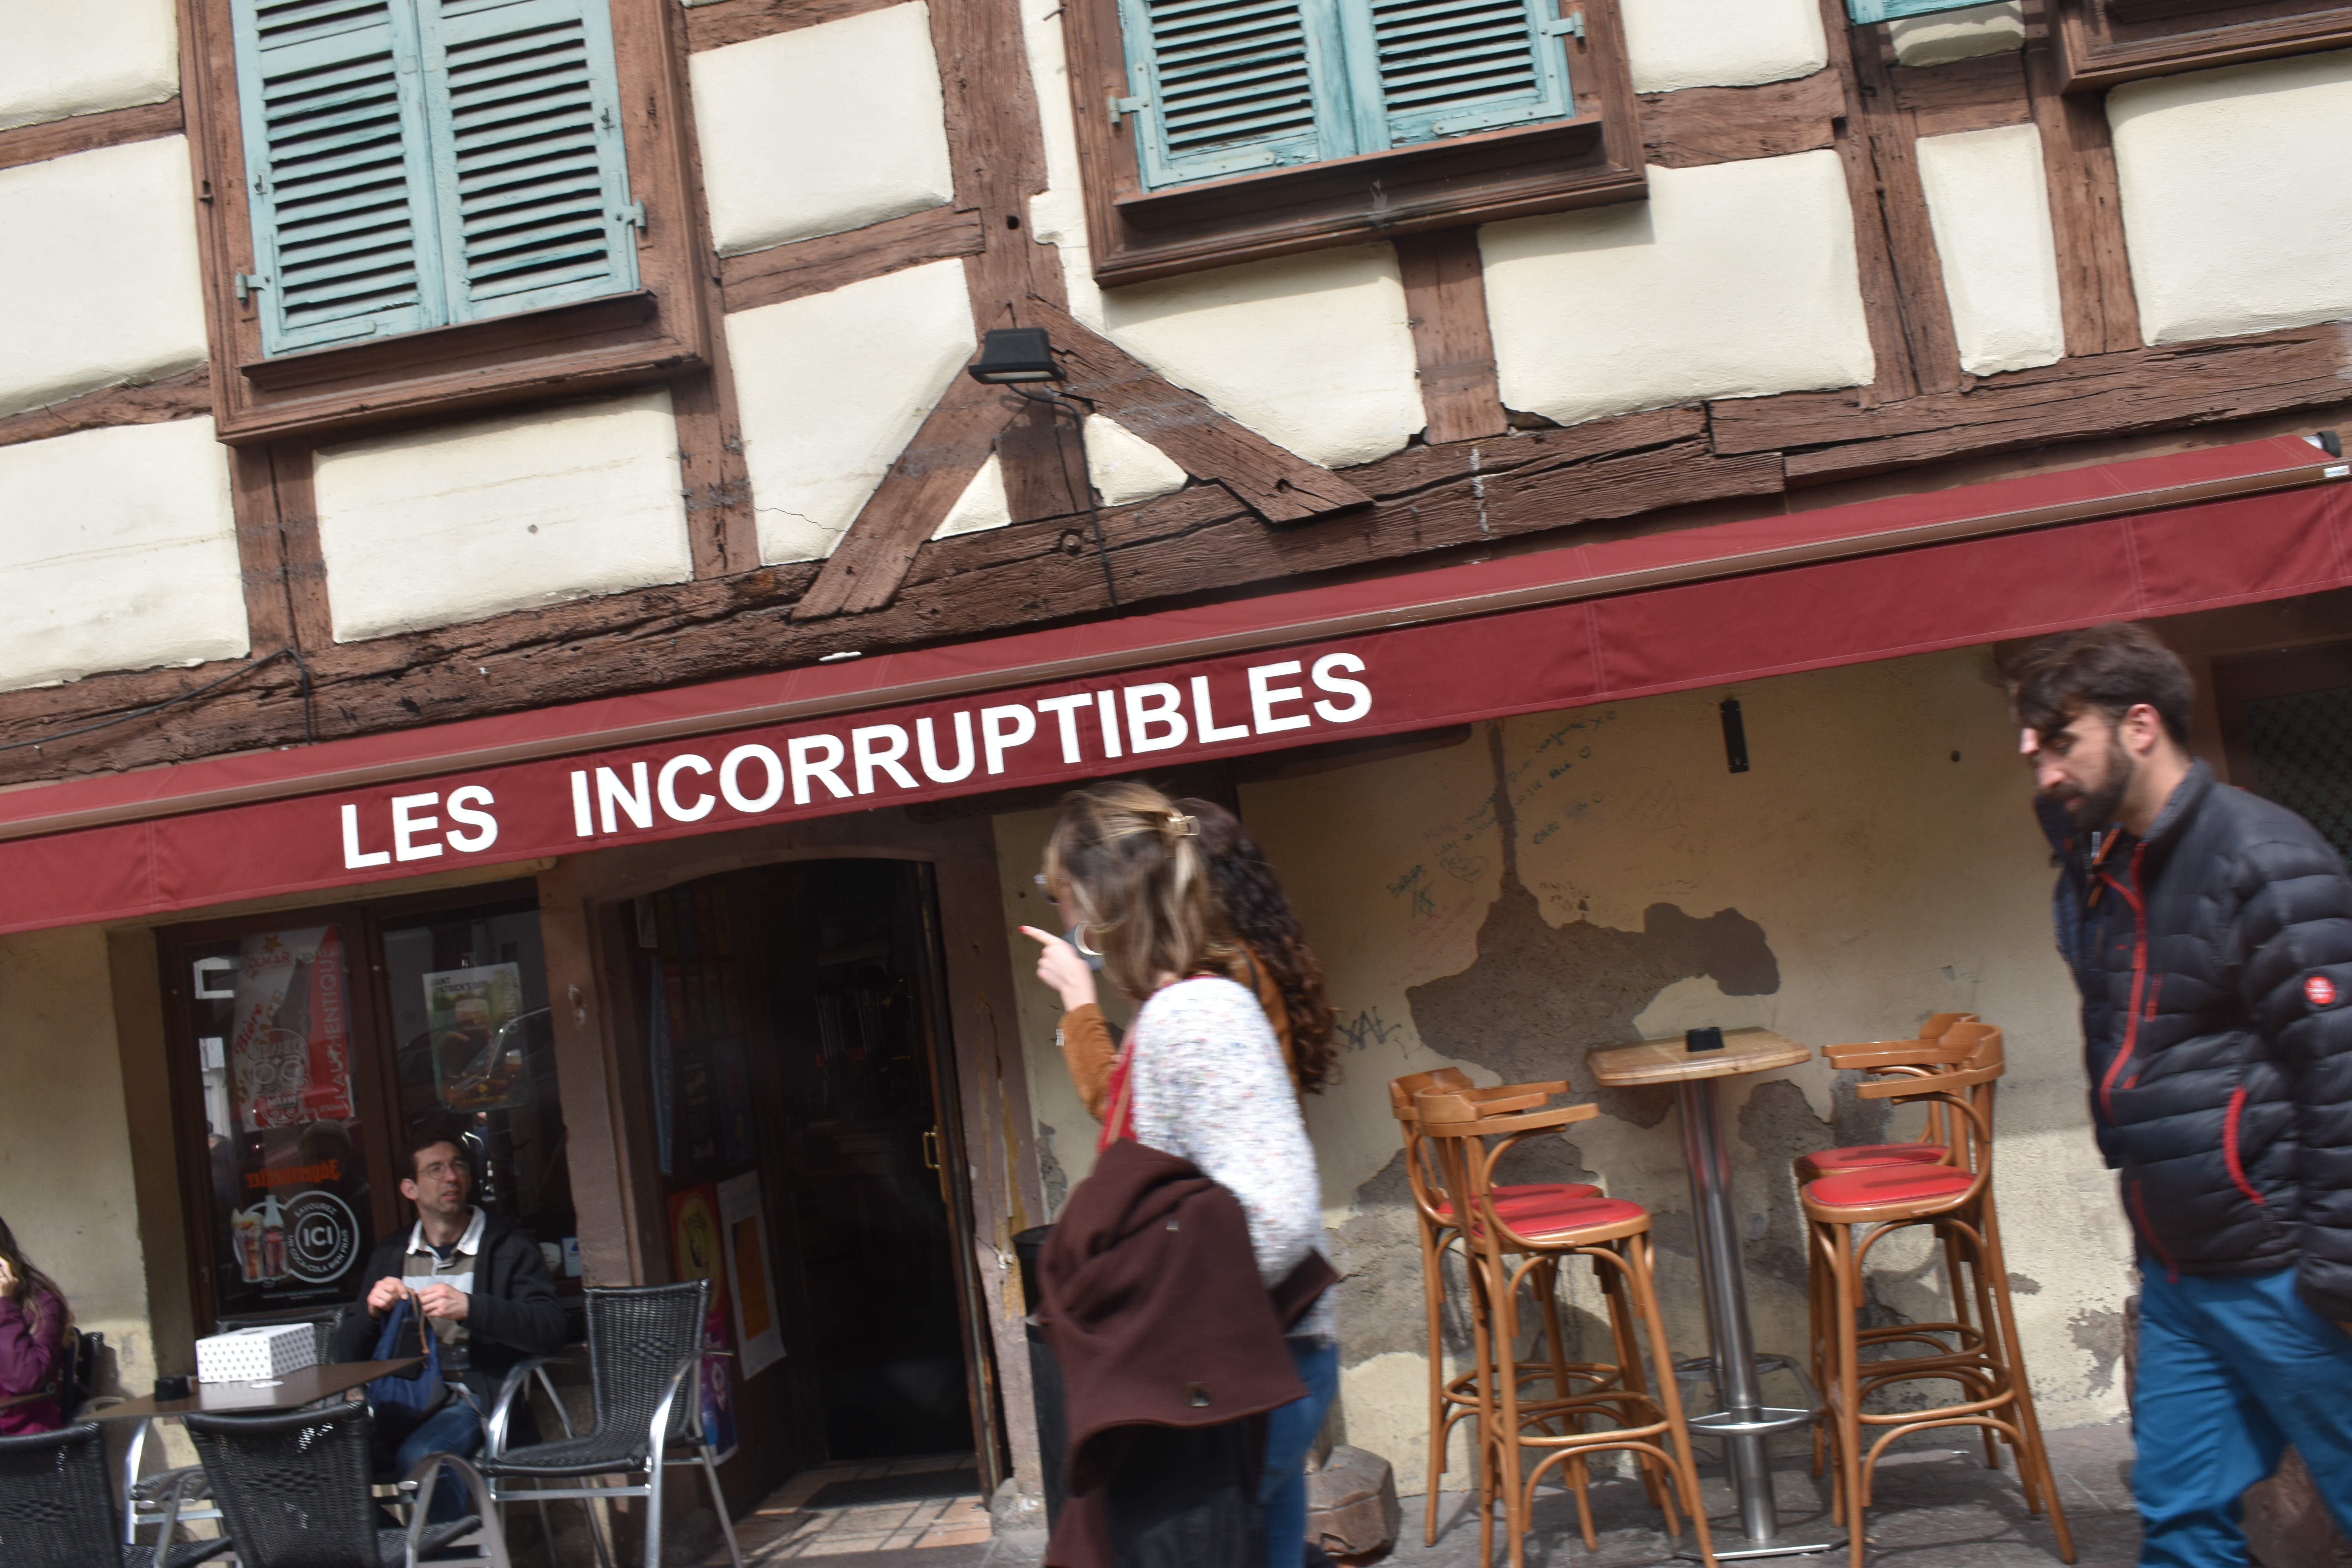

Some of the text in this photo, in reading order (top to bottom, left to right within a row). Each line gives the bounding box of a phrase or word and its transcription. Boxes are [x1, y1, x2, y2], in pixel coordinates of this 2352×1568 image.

[341, 785, 498, 869] LES
[570, 653, 1372, 837] INCORRUPTIBLES
[294, 1202, 338, 1218] SAVOUREZ
[303, 1225, 334, 1247] ICI
[327, 1252, 345, 1269] BIEN
[339, 1228, 349, 1254] FRAIS
